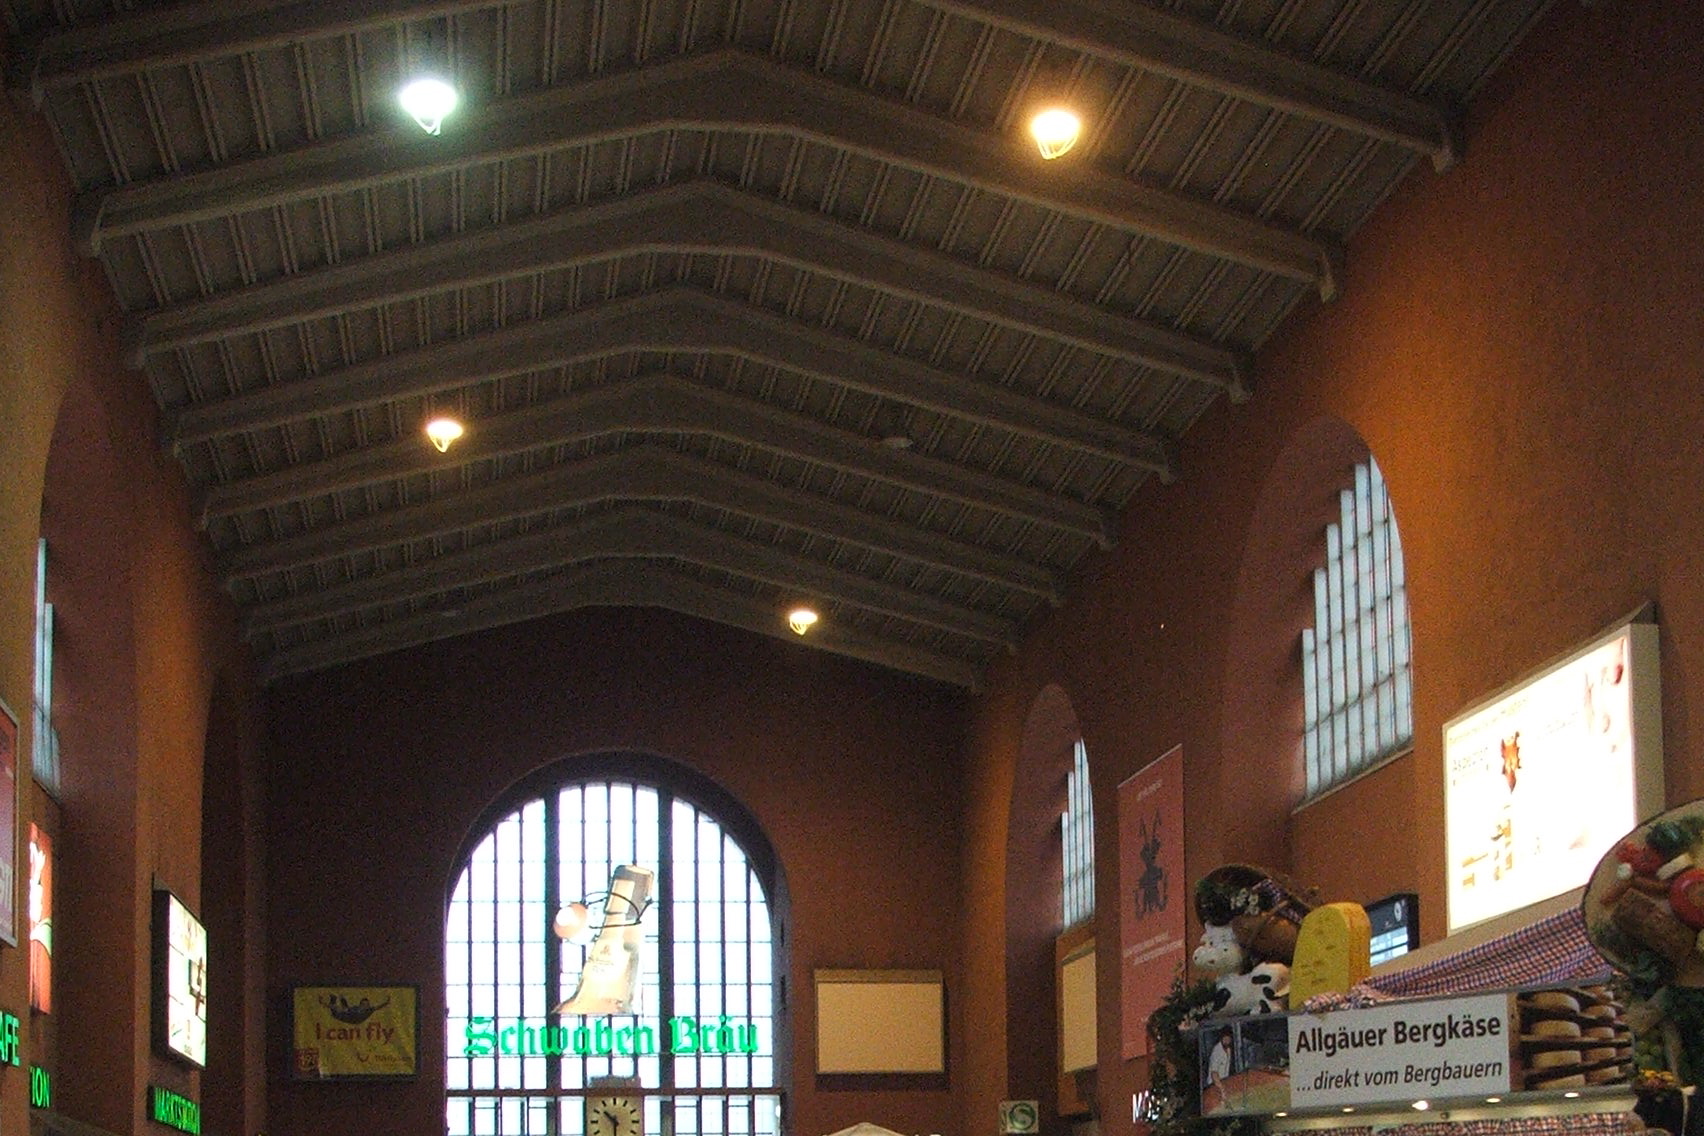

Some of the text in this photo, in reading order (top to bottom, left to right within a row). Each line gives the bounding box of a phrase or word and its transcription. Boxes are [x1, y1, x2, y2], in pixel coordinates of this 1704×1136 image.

[315, 1022, 395, 1045] I can fly
[464, 1014, 758, 1056] Schwaben Bräu
[1296, 1014, 1500, 1057] Allgäuer Bergkäse
[1364, 1070, 1399, 1086] vom
[1404, 1061, 1503, 1086] Bergbauern
